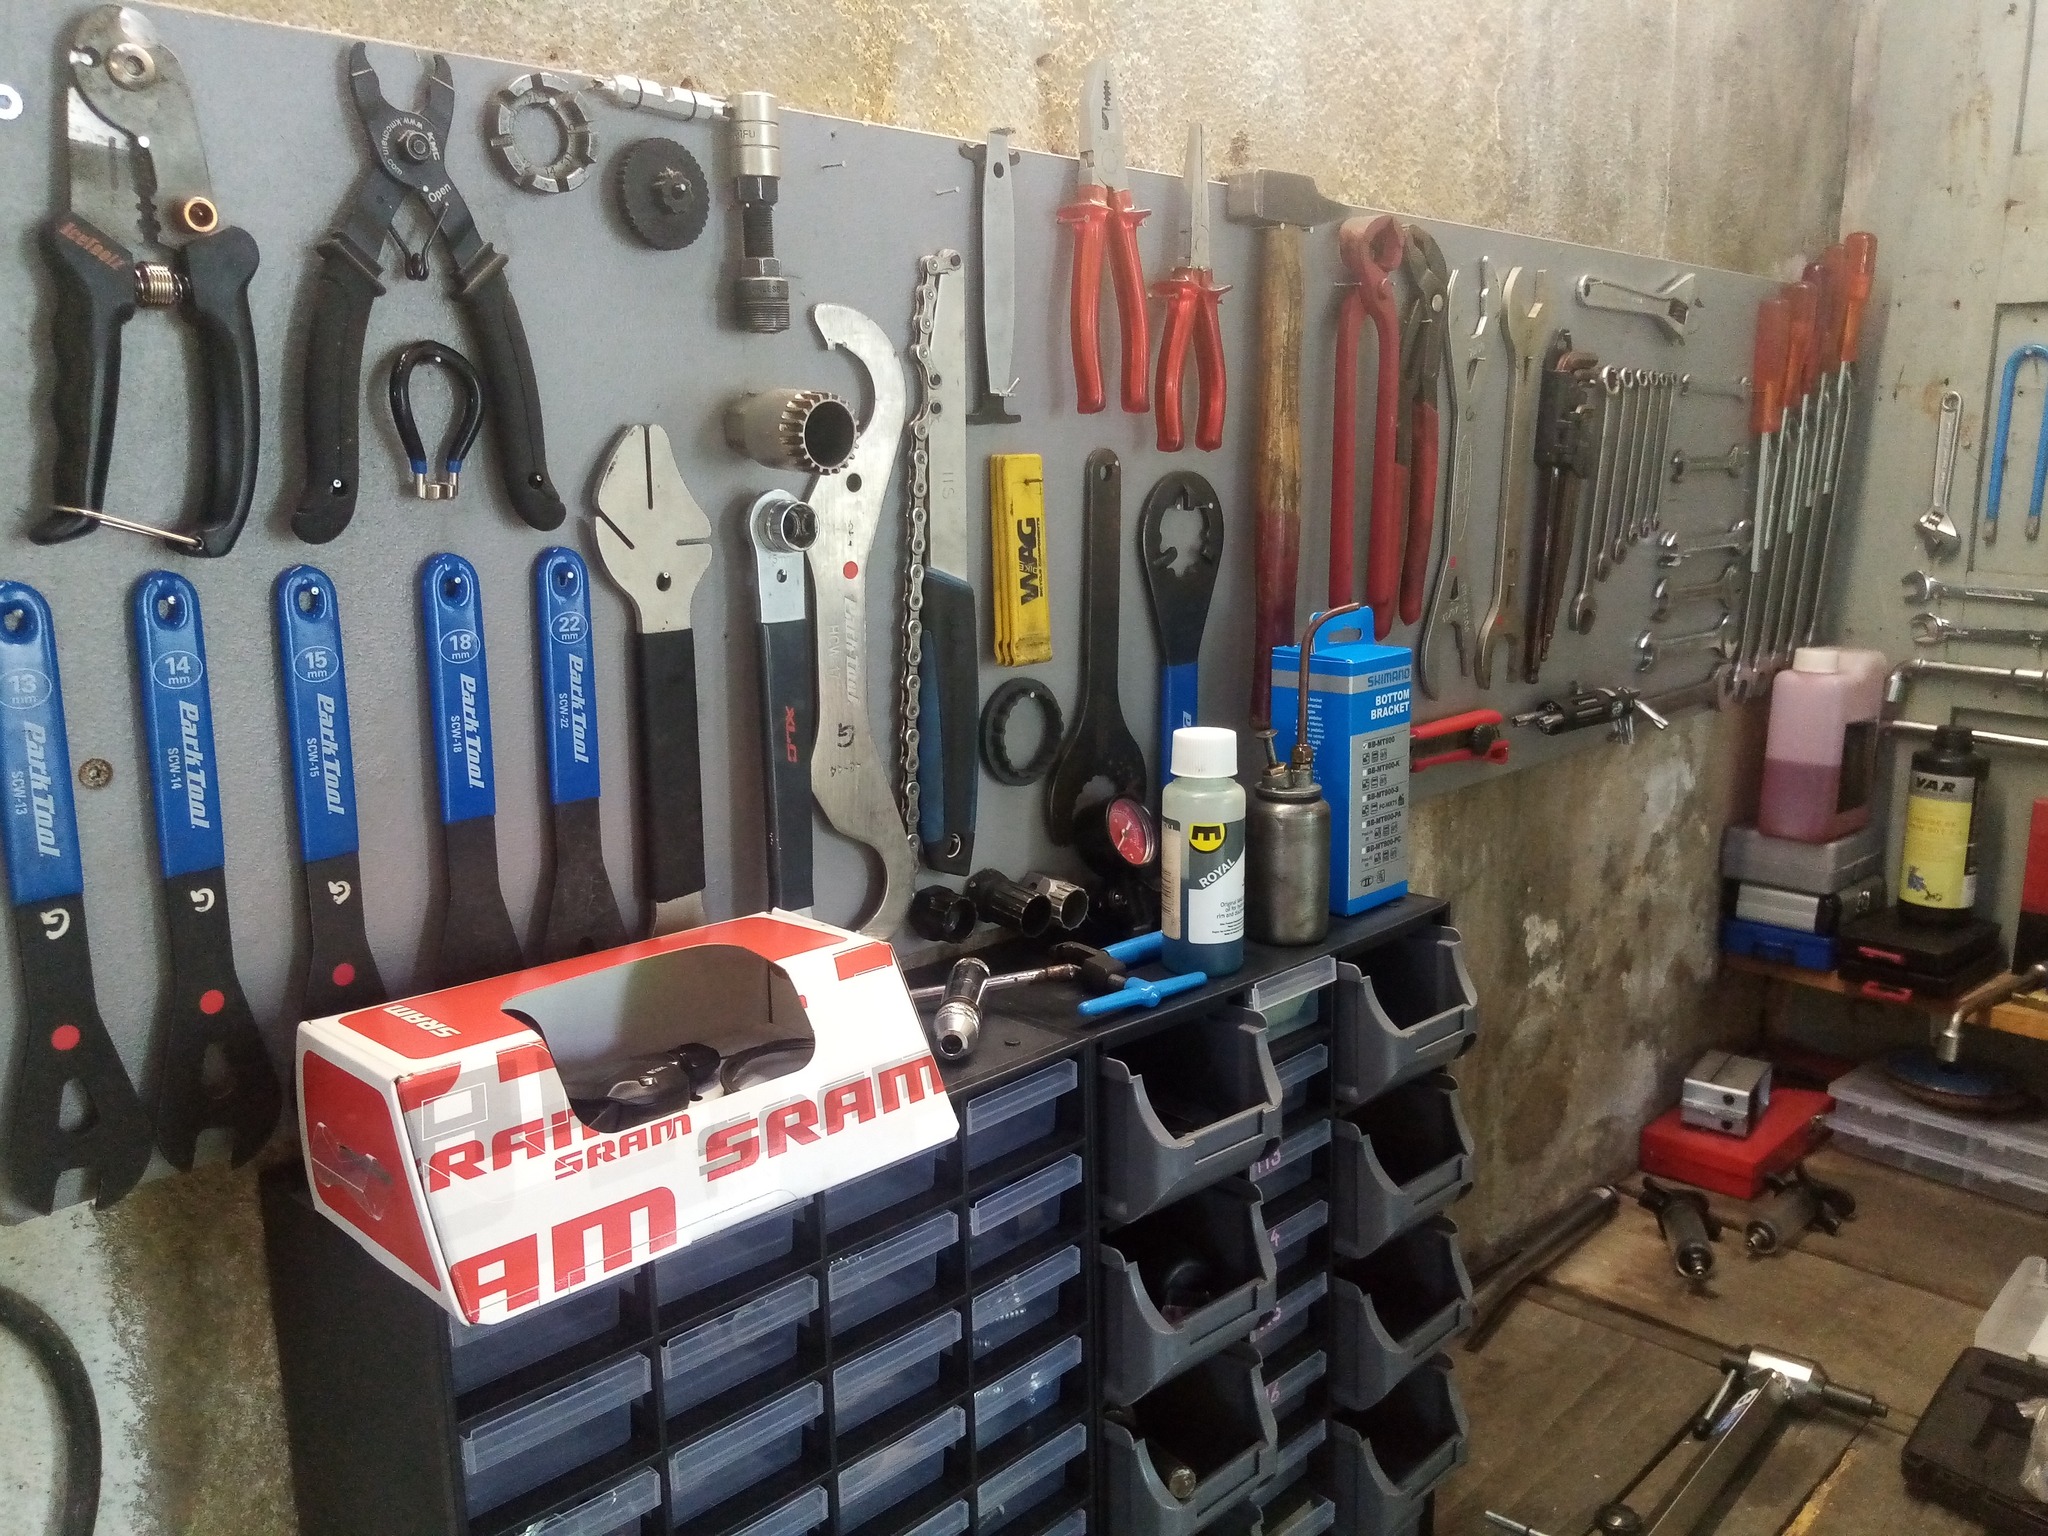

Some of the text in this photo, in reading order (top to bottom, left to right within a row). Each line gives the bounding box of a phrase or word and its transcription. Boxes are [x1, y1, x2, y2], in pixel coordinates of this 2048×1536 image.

[427, 131, 440, 161] KMC
[428, 183, 452, 203] Open
[1017, 517, 1039, 606] WAG
[558, 616, 581, 633] 22
[450, 634, 472, 651] 18
[561, 633, 579, 641] mm
[305, 650, 328, 670] 15
[451, 651, 470, 660] mm
[165, 656, 191, 676] 14
[307, 669, 328, 680] mm
[9, 674, 37, 694] 13
[168, 676, 191, 685] mm
[1367, 668, 1411, 688] SHIMANO
[1375, 689, 1410, 706] BOTTOM
[558, 692, 570, 729] SCW-22
[1370, 702, 1410, 720] BRACKET
[450, 715, 463, 754] SCW-18
[306, 737, 320, 778] SCW-15
[167, 746, 183, 791] SCW-14
[11, 770, 28, 816] SCW-13
[1915, 777, 1957, 793] VAR
[1198, 858, 1237, 889] ROYAL
[383, 1004, 462, 1038] SRAM
[706, 1054, 944, 1183] SRAM
[555, 1113, 692, 1180] SRAM
